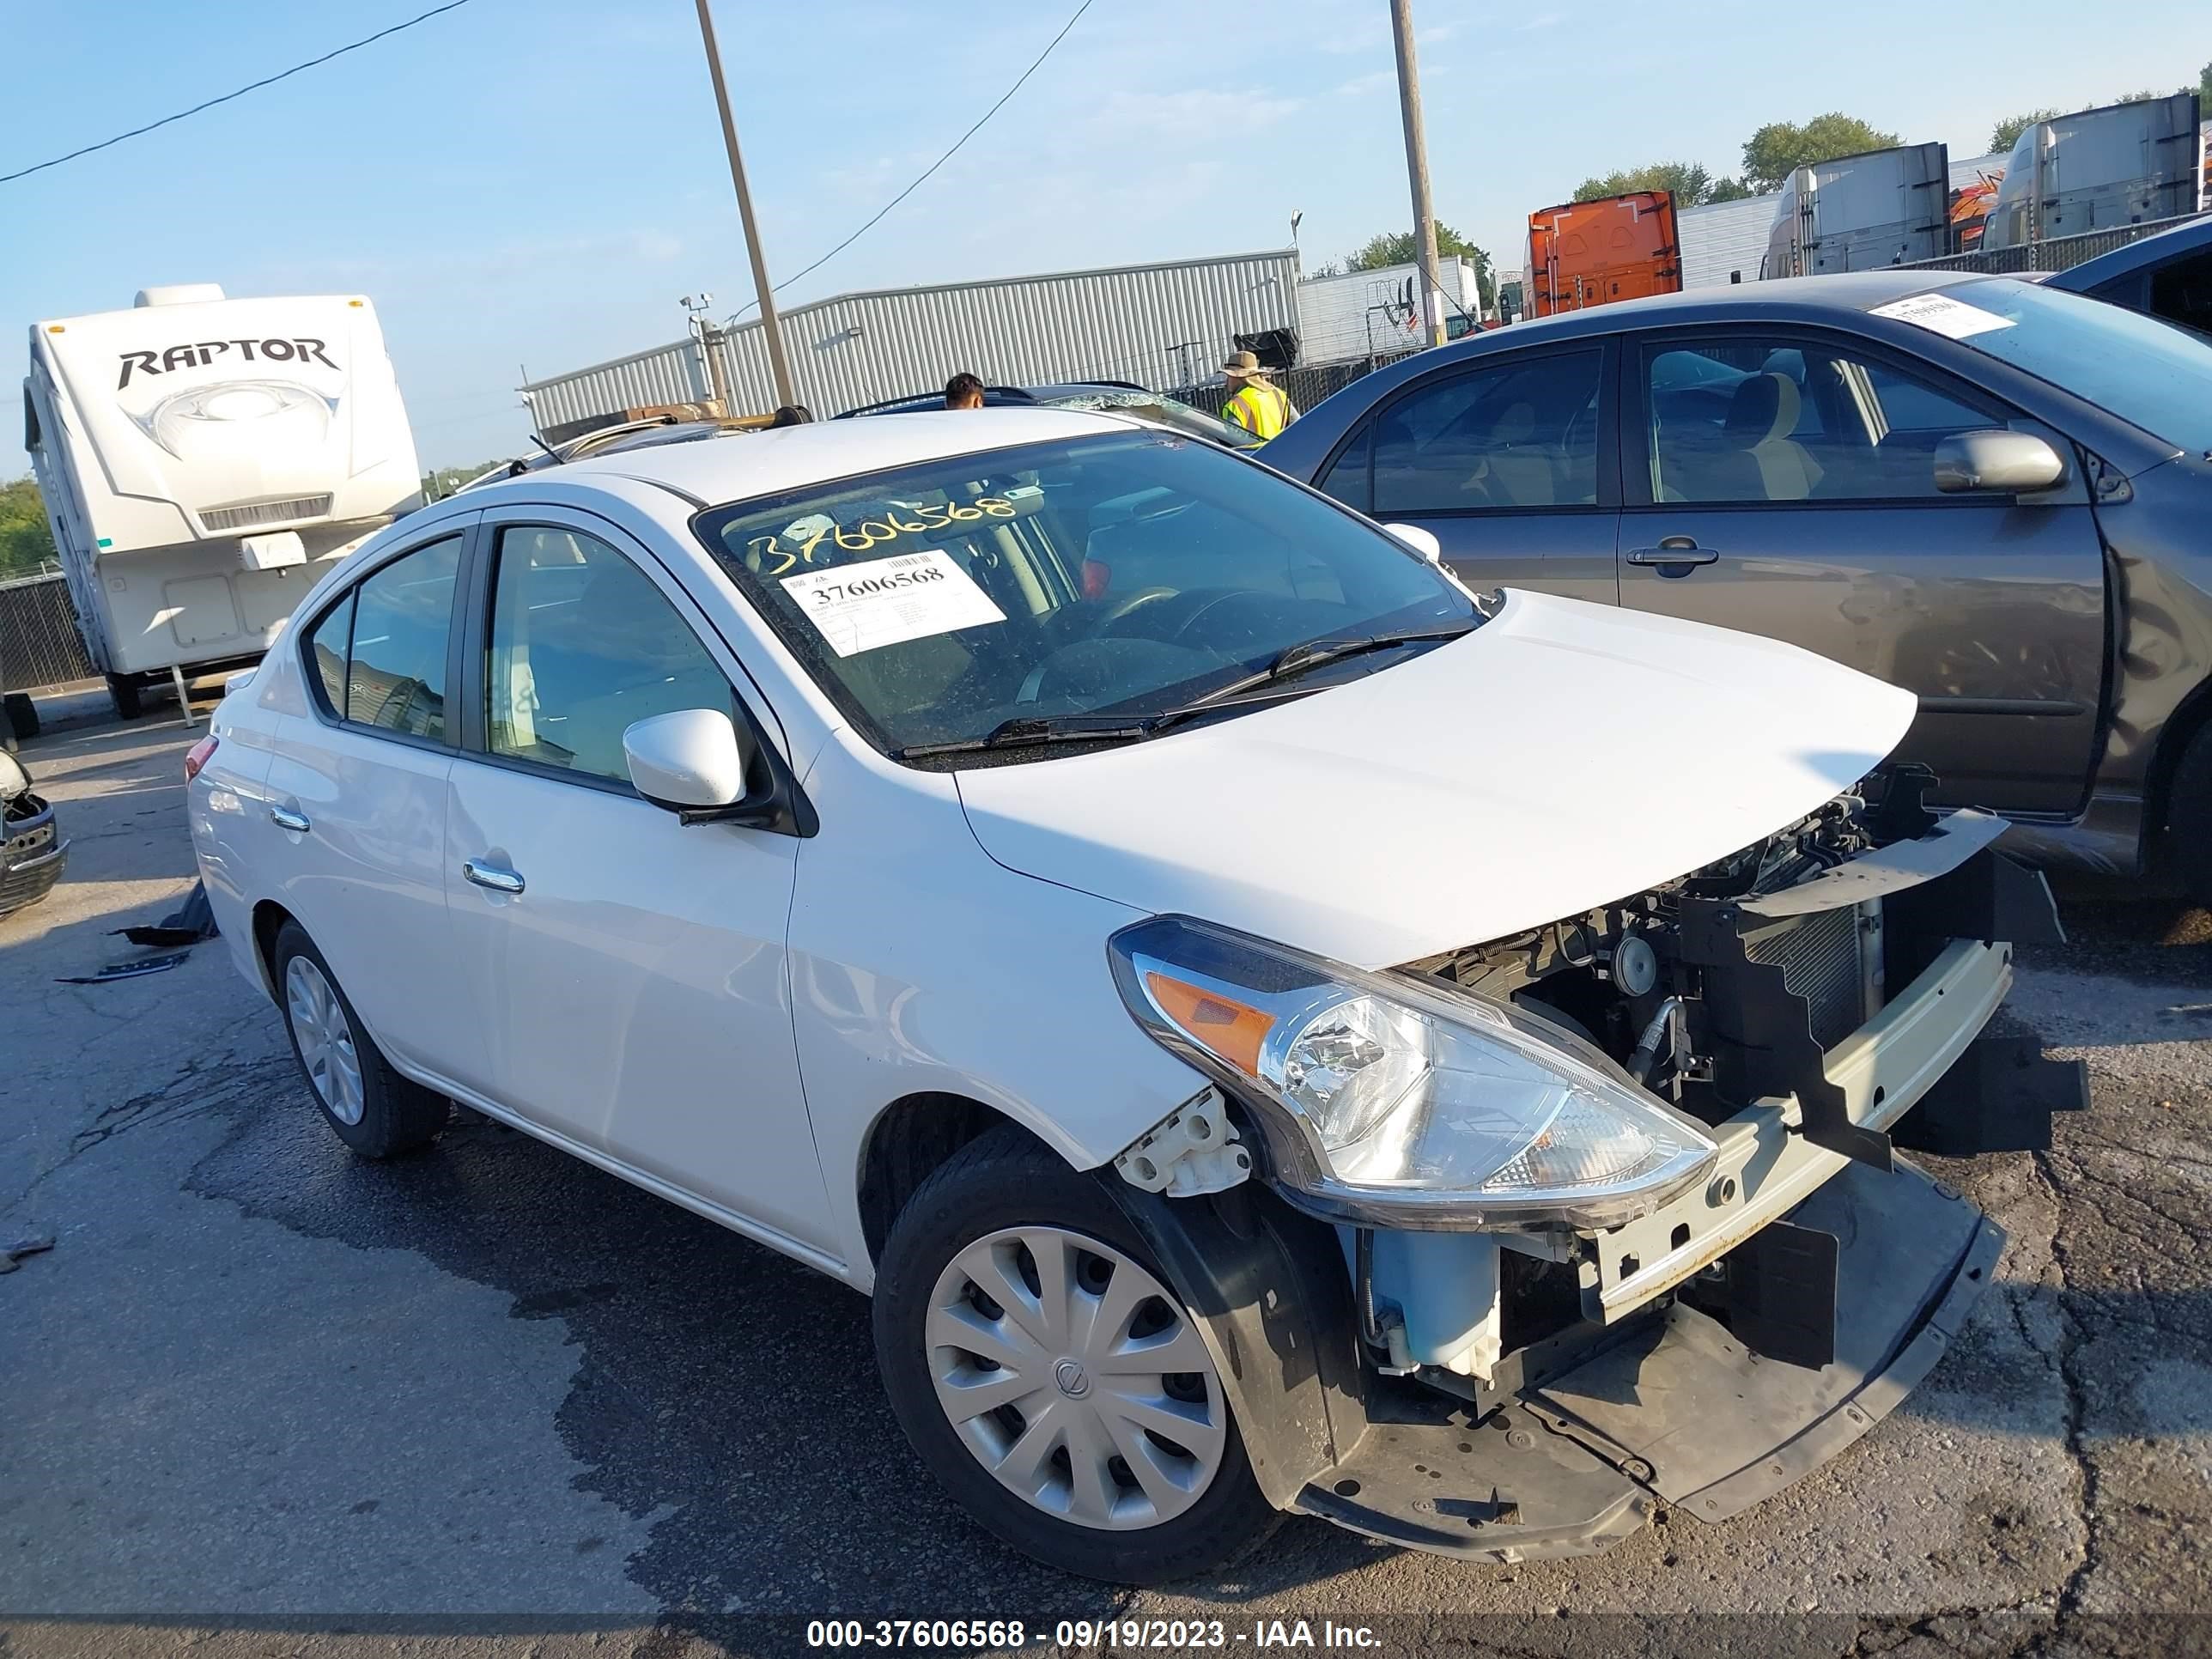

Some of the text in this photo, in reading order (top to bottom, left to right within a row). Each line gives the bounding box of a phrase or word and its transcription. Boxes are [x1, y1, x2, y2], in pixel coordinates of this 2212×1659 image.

[117, 338, 342, 392] RAPTOR
[747, 497, 1017, 575] 37606568
[811, 567, 945, 605] 37606568
